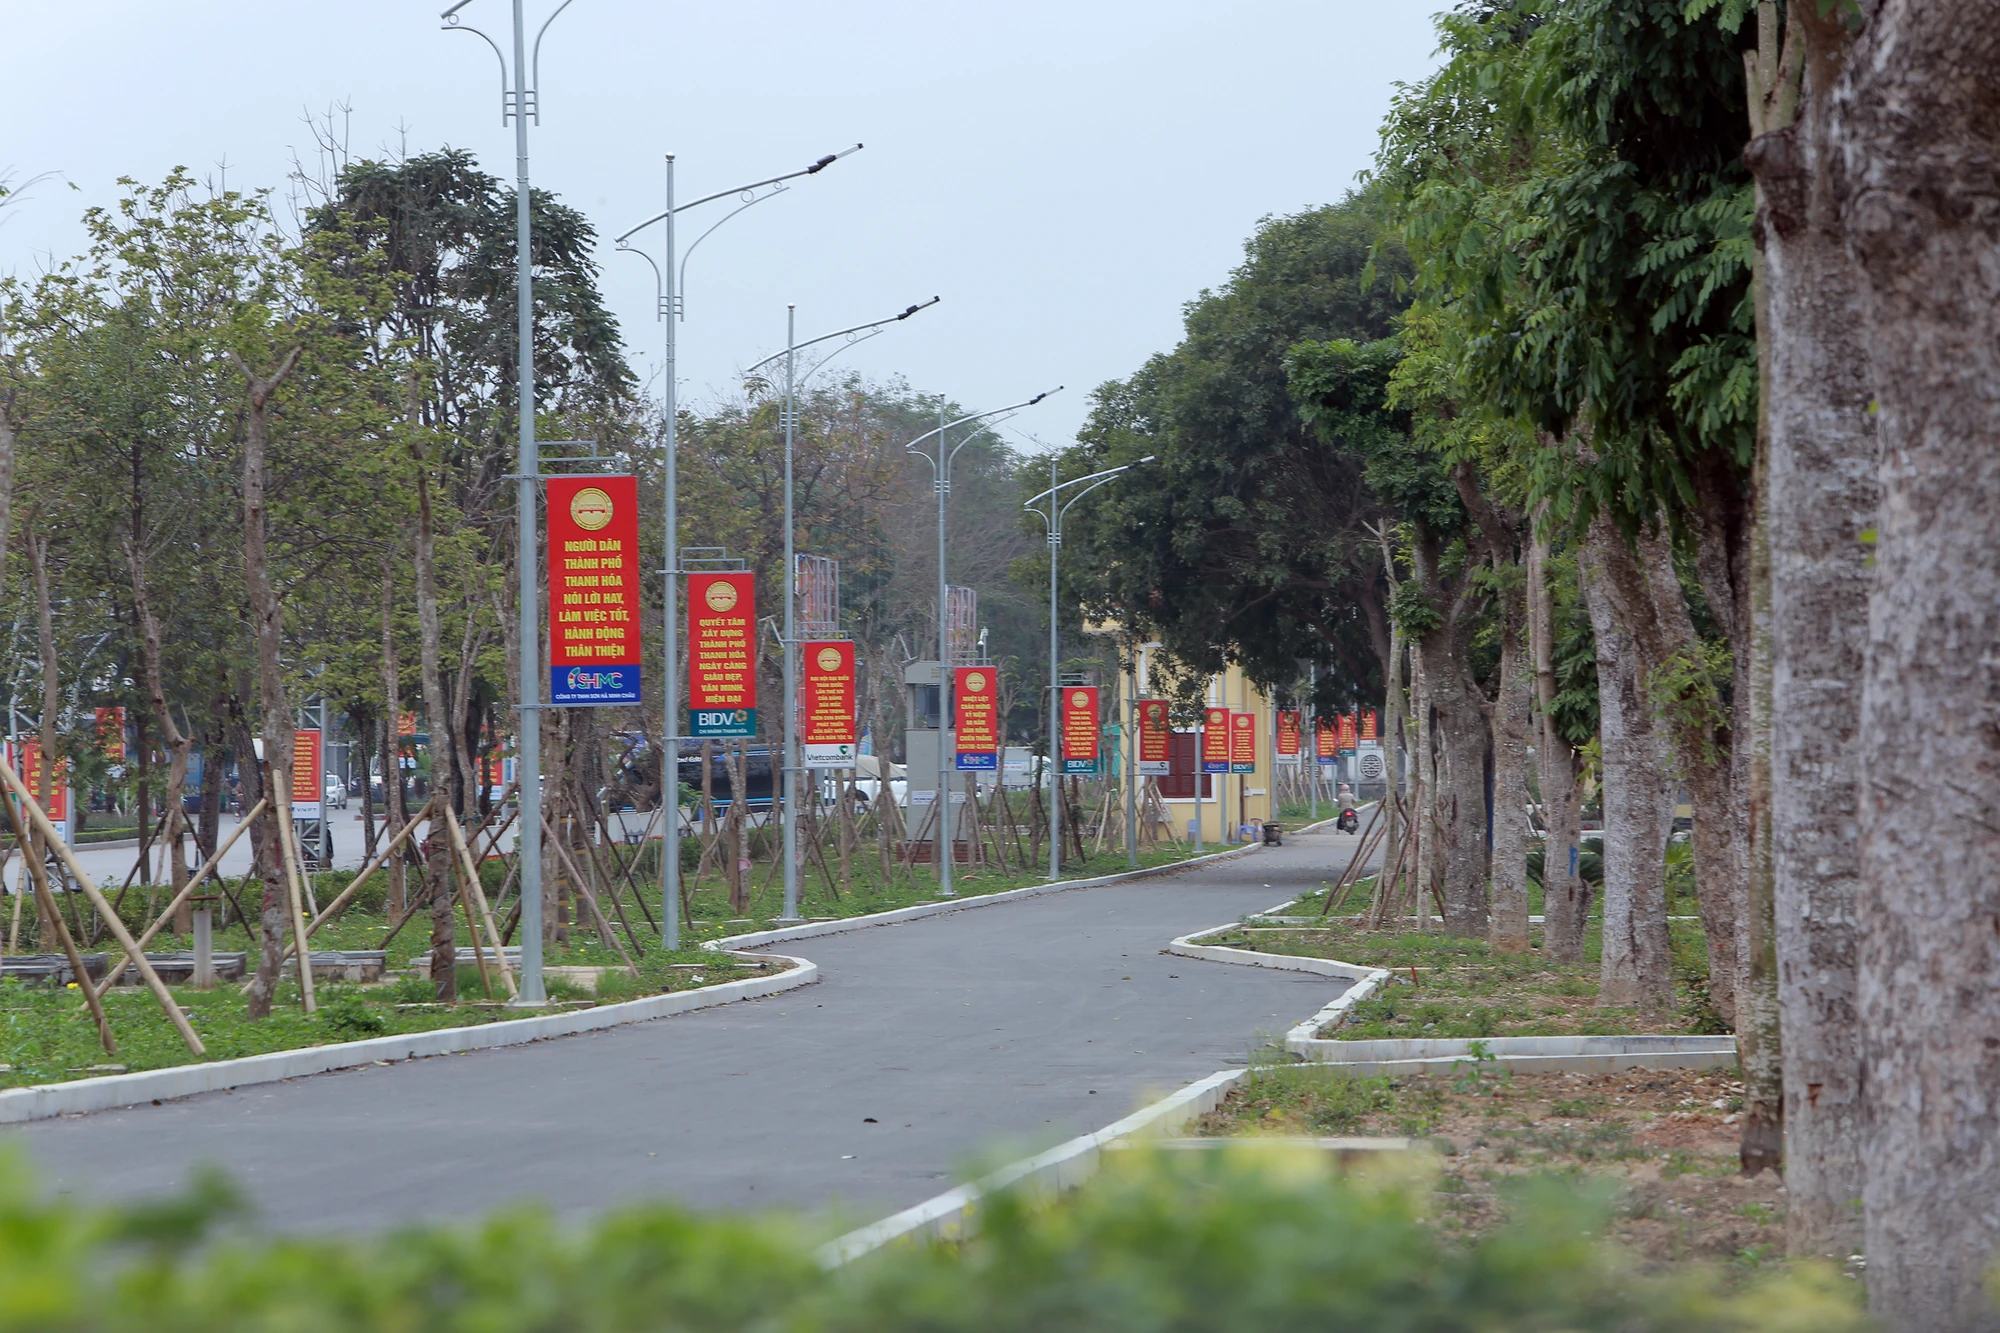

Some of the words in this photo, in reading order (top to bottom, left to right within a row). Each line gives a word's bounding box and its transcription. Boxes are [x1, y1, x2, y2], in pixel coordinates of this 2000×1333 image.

[564, 538, 596, 551] NGƯỜI
[600, 538, 621, 551] DÂN
[564, 556, 598, 569] THÀNH
[601, 554, 622, 568] PHỐ
[564, 576, 598, 586] THANH
[602, 573, 623, 586] HÓA
[563, 592, 582, 604] NÓI
[585, 591, 600, 604] LỜI
[604, 593, 624, 604] HAY,
[559, 609, 581, 622] LÀM
[584, 609, 607, 624] VIỆC
[609, 607, 630, 622] TỐT,
[564, 627, 593, 640] HÀNH
[596, 626, 625, 641] ĐỘNG
[564, 644, 592, 657] THÂN
[596, 644, 625, 658] THIỆN
[577, 672, 623, 689] SHMC
[699, 712, 734, 726] BIDV
